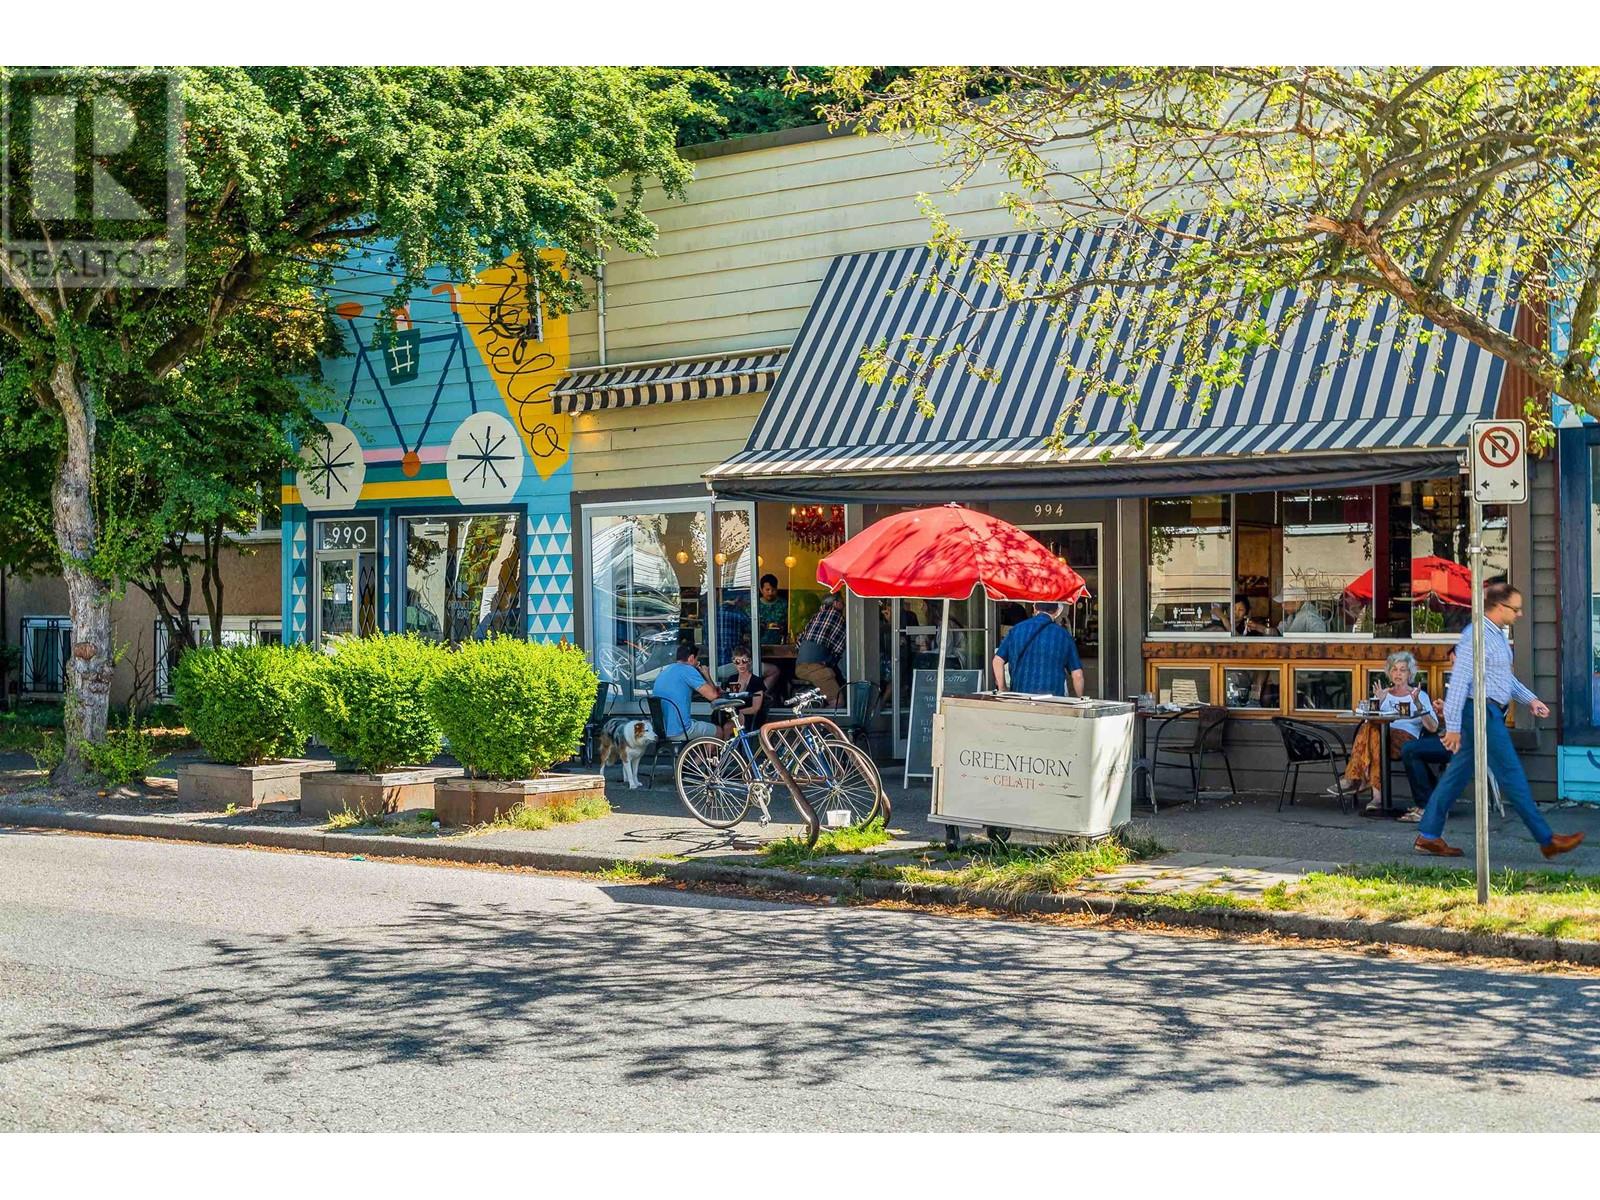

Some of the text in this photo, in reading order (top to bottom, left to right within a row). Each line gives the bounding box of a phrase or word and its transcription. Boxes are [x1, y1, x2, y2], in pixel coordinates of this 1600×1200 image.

[1034, 503, 1064, 517] 994
[332, 526, 367, 544] 990
[959, 749, 1072, 777] GREENHORN
[993, 775, 1035, 790] GELATI
